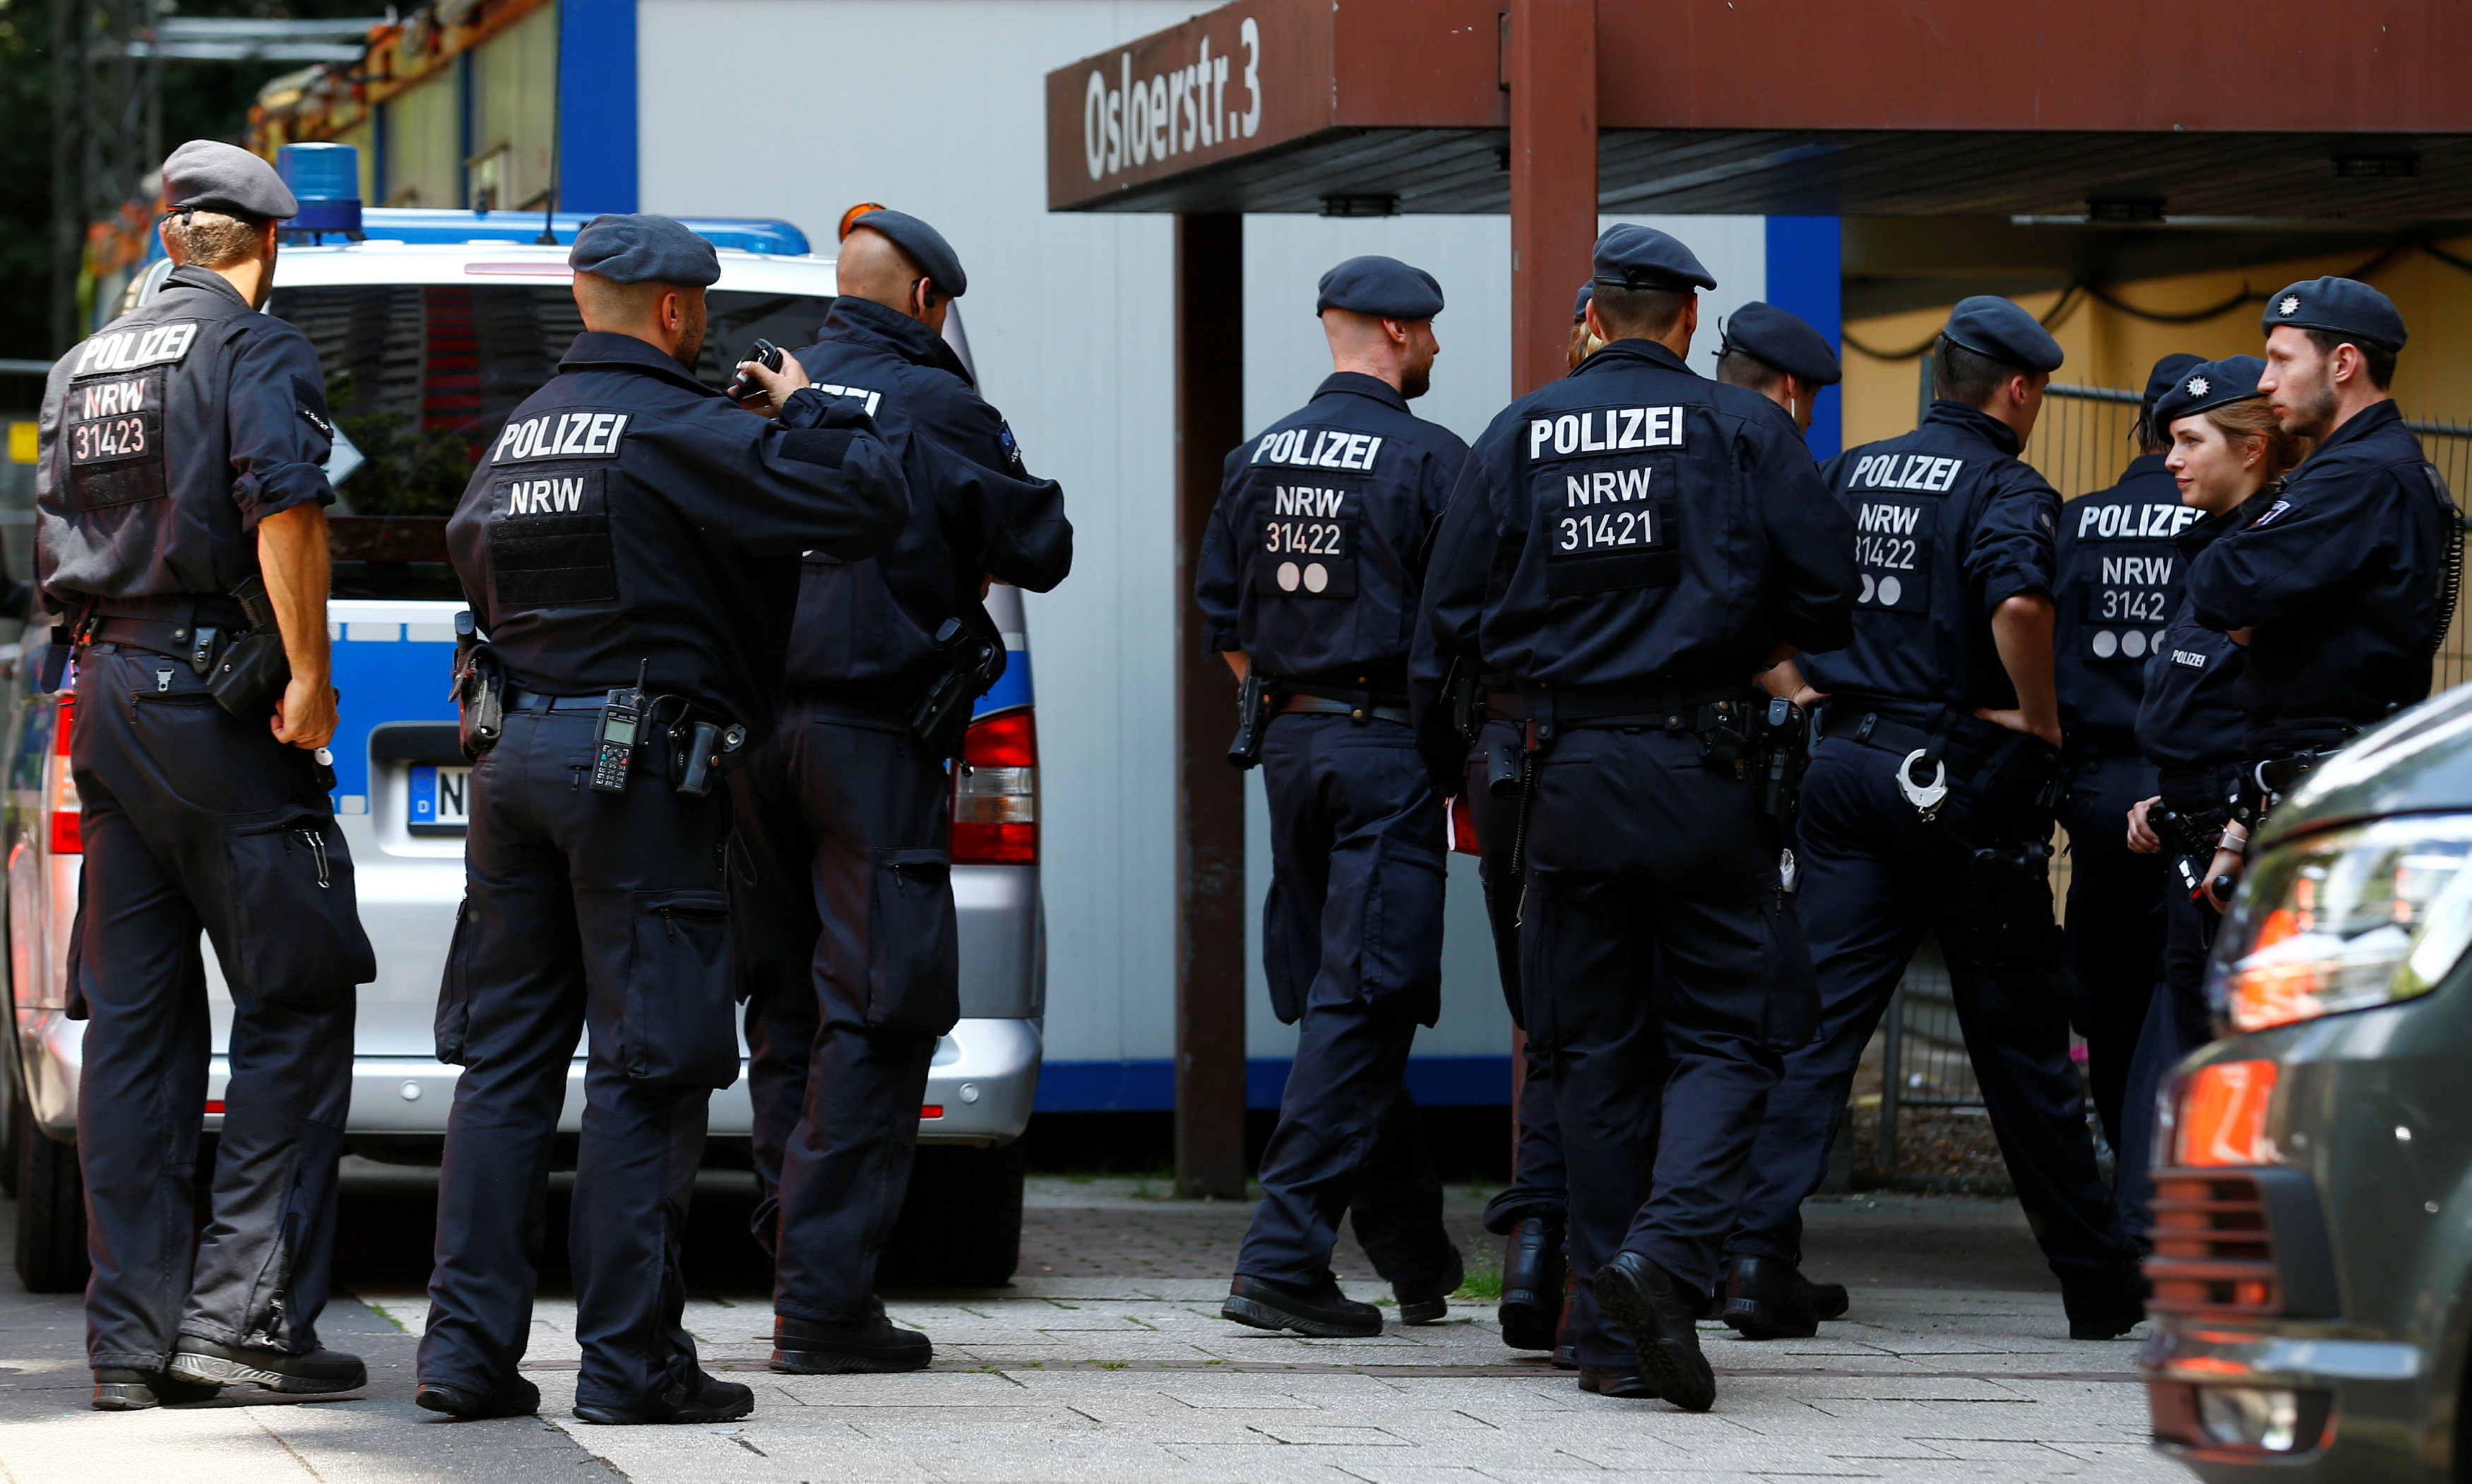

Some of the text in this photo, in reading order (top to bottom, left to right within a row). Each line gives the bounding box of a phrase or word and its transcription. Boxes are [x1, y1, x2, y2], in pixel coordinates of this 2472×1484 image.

[73, 323, 198, 374] POLIZEI
[83, 379, 145, 420] NRW
[76, 417, 145, 460] 31423
[492, 412, 629, 462] POLIZEI
[1251, 429, 1383, 470] POLIZEI
[1530, 407, 1684, 460] POLIZEI
[1567, 467, 1652, 508] NRW
[1848, 453, 1963, 492] POLIZEI
[508, 477, 585, 516] NRW
[1274, 485, 1345, 518] NRW
[1559, 509, 1653, 551] 31421
[1858, 502, 1921, 536] NRW
[1266, 523, 1341, 555] 31422
[2102, 556, 2173, 586] NRW
[2102, 589, 2165, 622] 3142
[2170, 648, 2206, 668] POLIZEI
[417, 800, 430, 814] D
